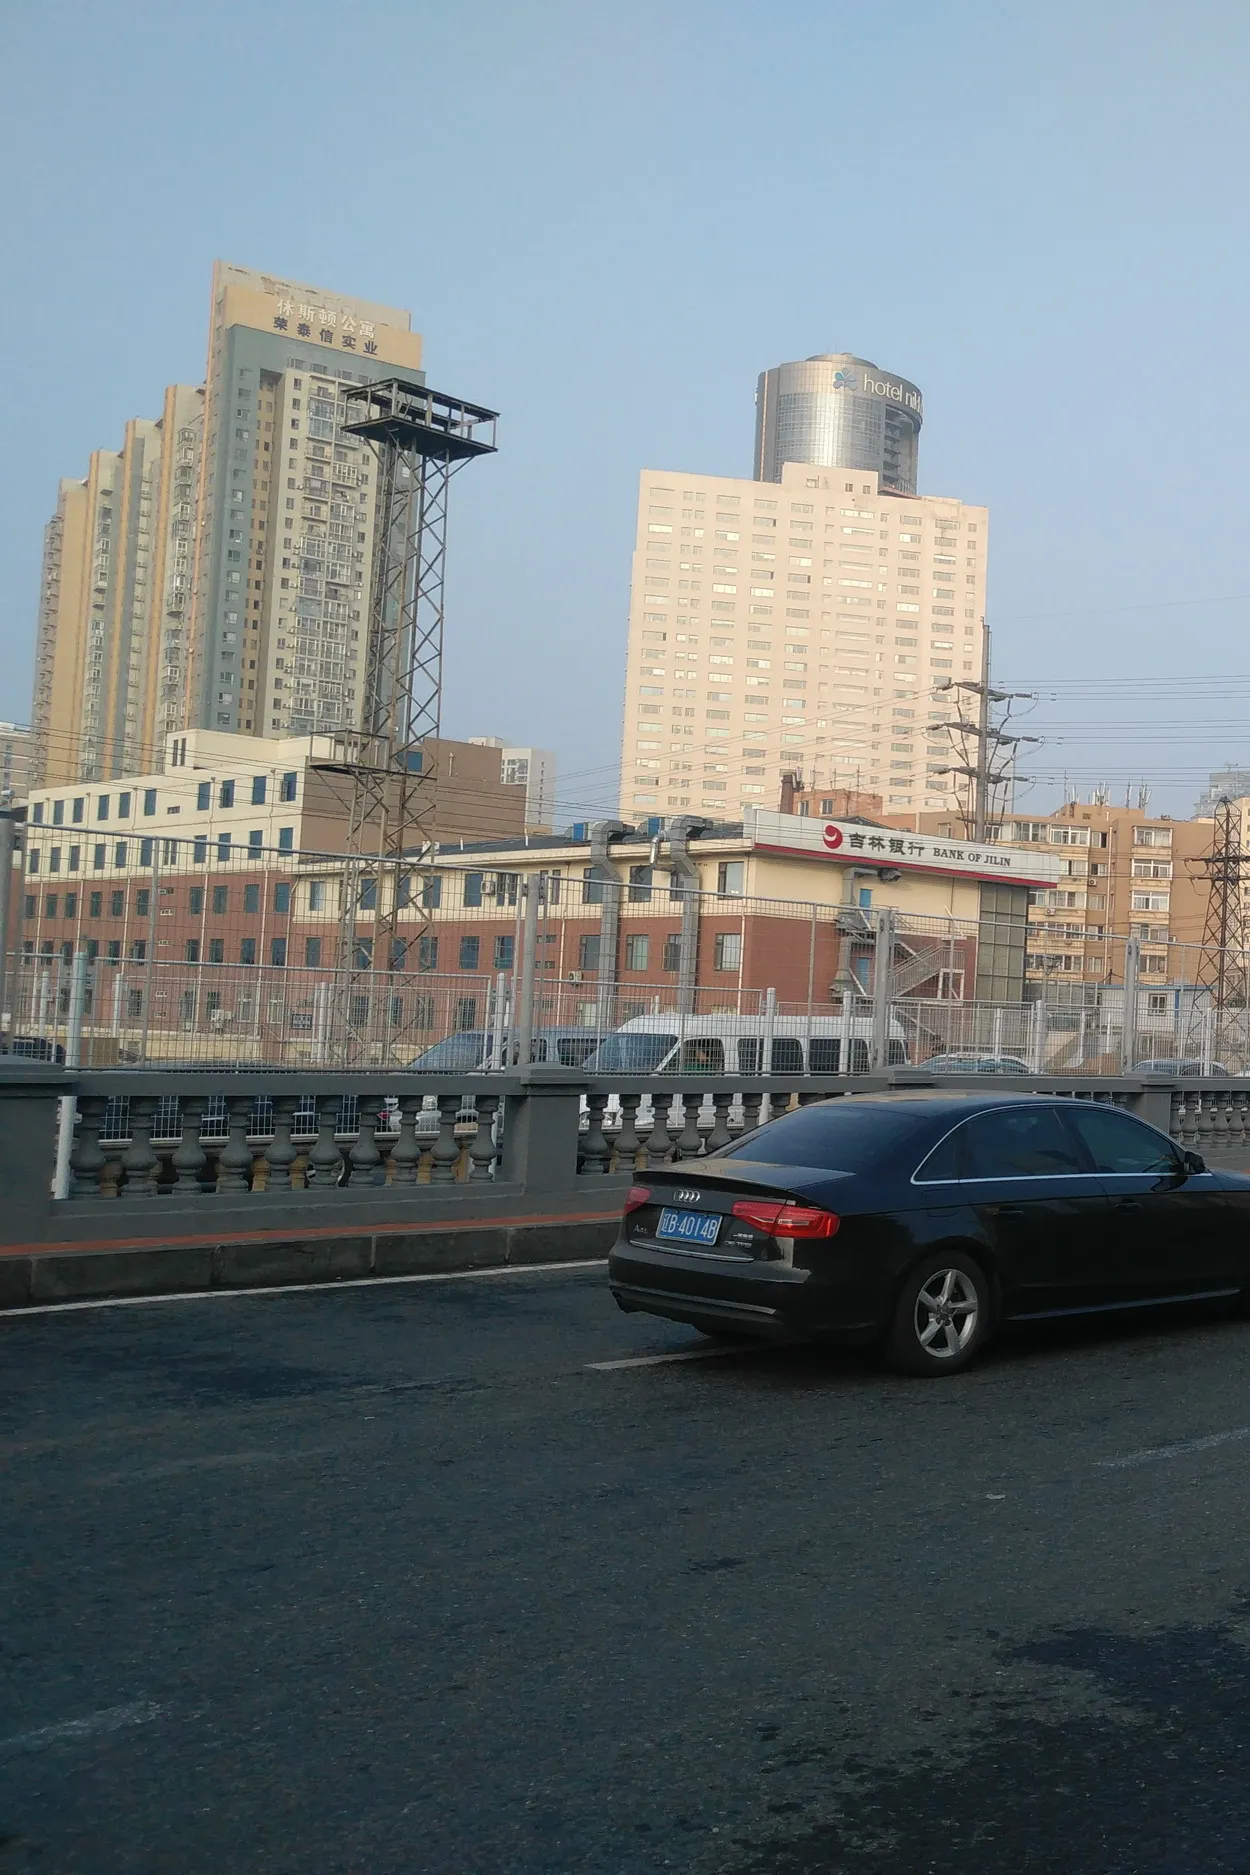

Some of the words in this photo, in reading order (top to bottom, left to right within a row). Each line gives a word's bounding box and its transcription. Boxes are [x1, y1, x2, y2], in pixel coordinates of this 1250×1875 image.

[273, 316, 378, 356] 荣泰信实业
[276, 298, 376, 339] 休斯顿公寓
[863, 373, 903, 402] hotel
[849, 832, 925, 857] 吉林银行
[933, 848, 964, 861] BANK
[968, 853, 982, 863] OF
[984, 854, 1011, 867] JILIN
